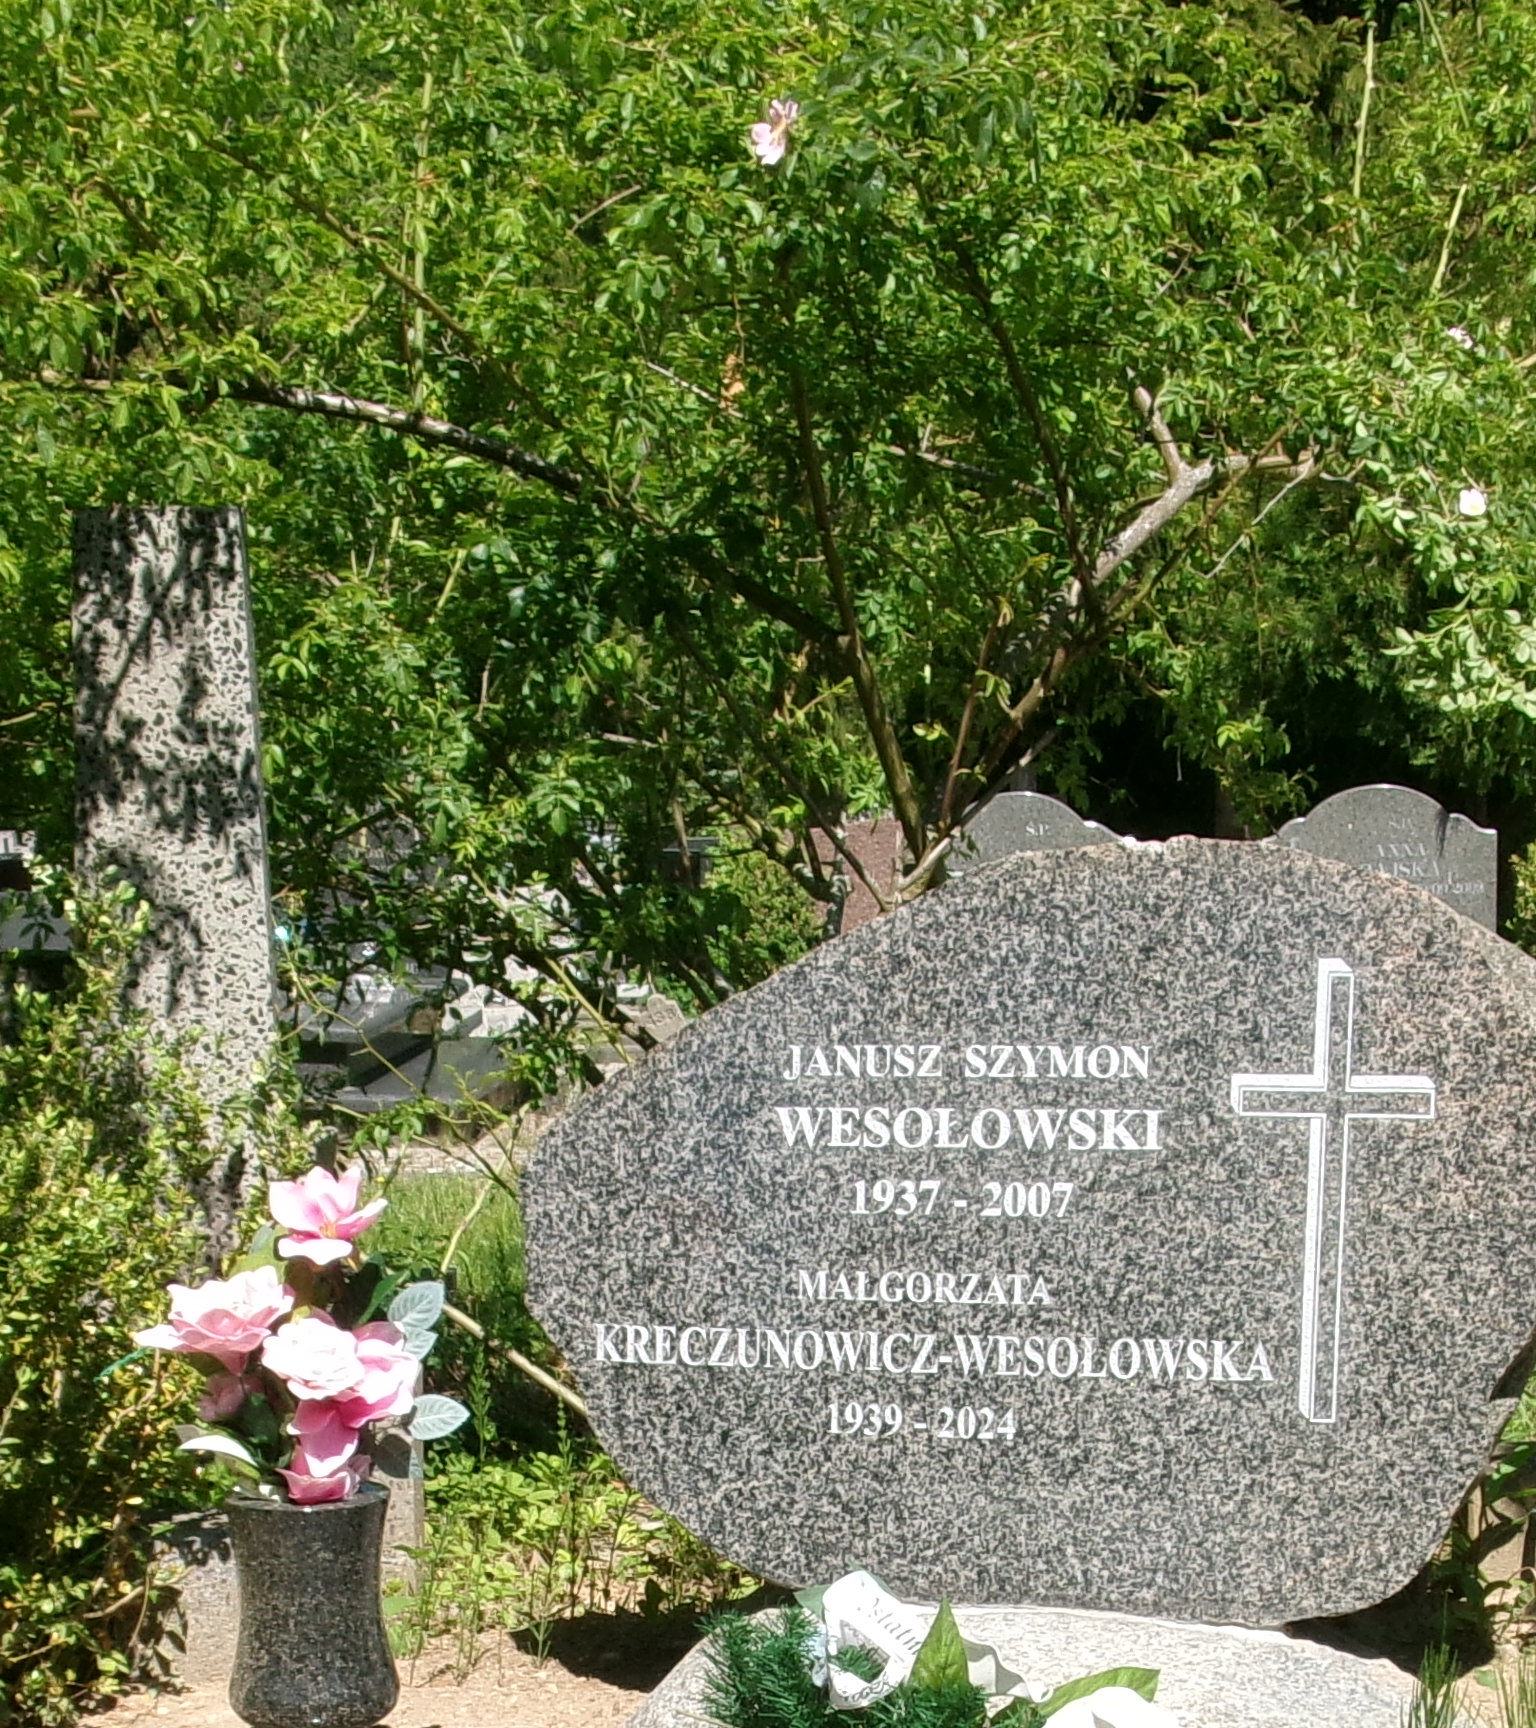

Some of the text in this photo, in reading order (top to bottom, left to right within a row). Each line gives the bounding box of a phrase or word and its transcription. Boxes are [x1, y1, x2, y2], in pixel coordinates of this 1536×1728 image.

[783, 1044, 1152, 1081] JANUSZ SZYMON
[774, 1105, 1165, 1152] WESOŁOWSKI
[850, 1179, 942, 1217] 1937
[980, 1181, 1075, 1219] 2007
[797, 1268, 1052, 1306] MAŁGORZATA
[594, 1322, 1276, 1384] KRECZUNOWICZ-WESOŁOWSKA
[827, 1402, 903, 1439] 1939
[937, 1404, 1018, 1442] 2024
